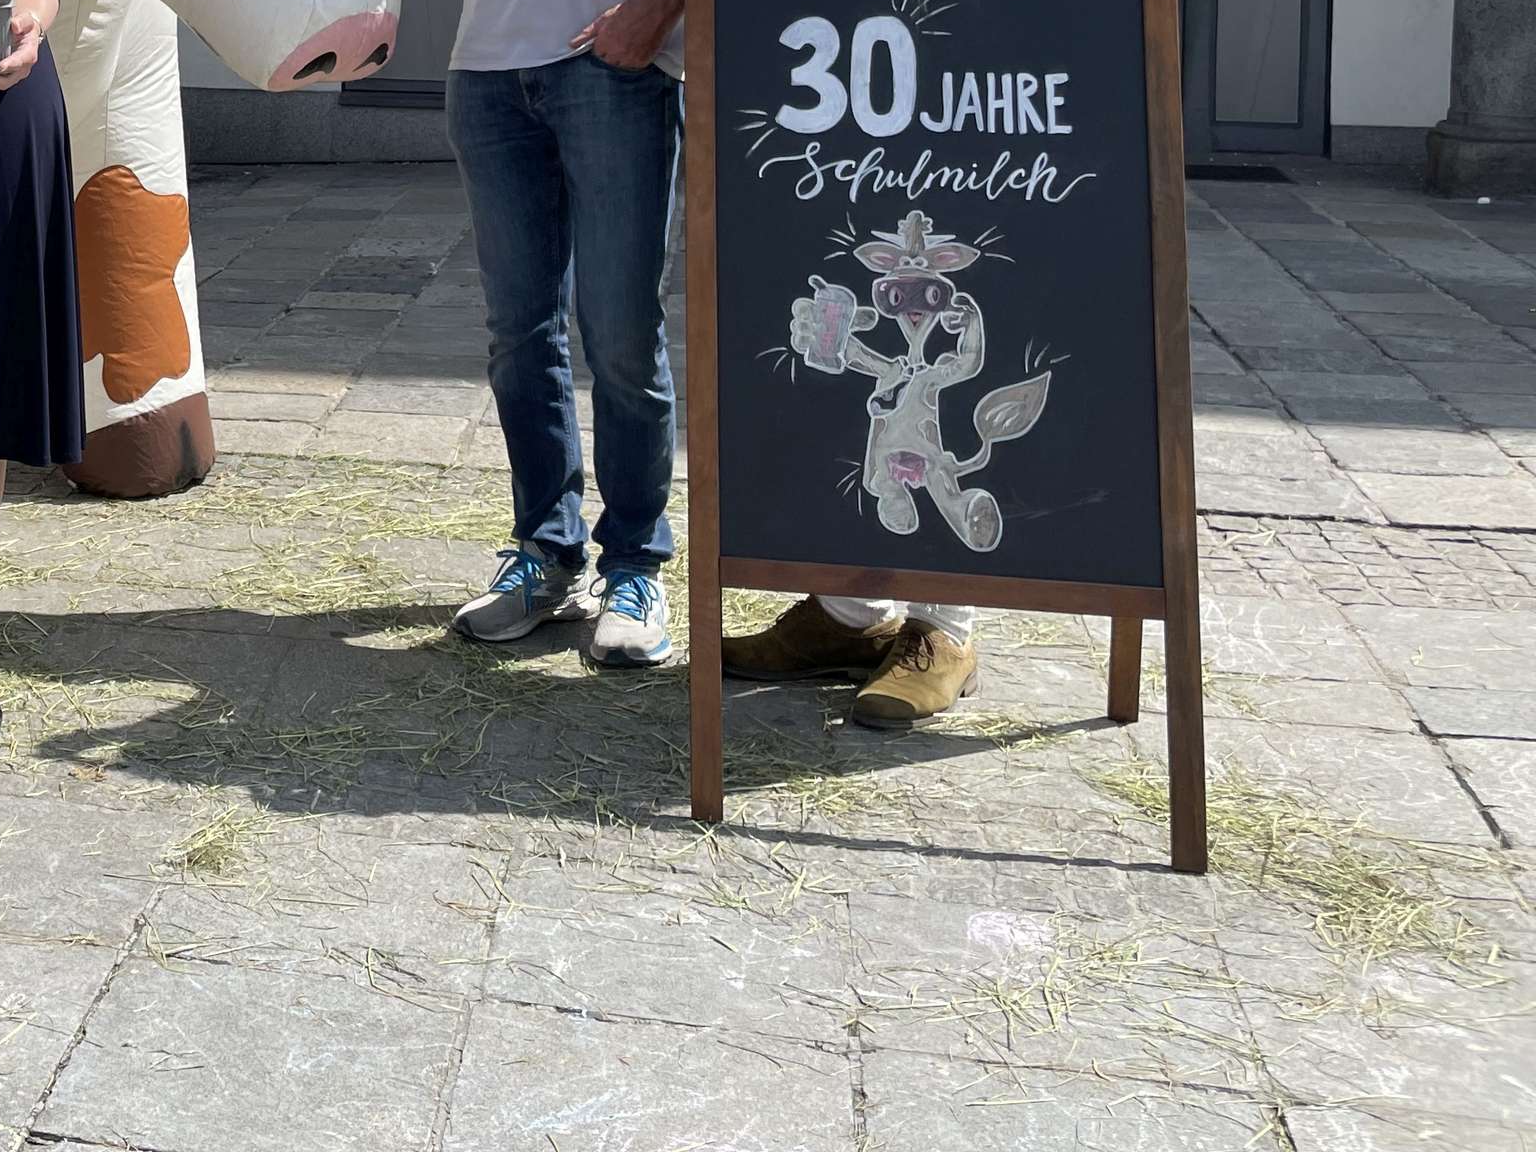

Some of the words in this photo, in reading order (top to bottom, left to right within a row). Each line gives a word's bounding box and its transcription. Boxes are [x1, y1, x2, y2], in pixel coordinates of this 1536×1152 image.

[775, 16, 917, 137] 30
[920, 71, 1072, 134] JAHRE
[759, 141, 1097, 203] Schulmilch
